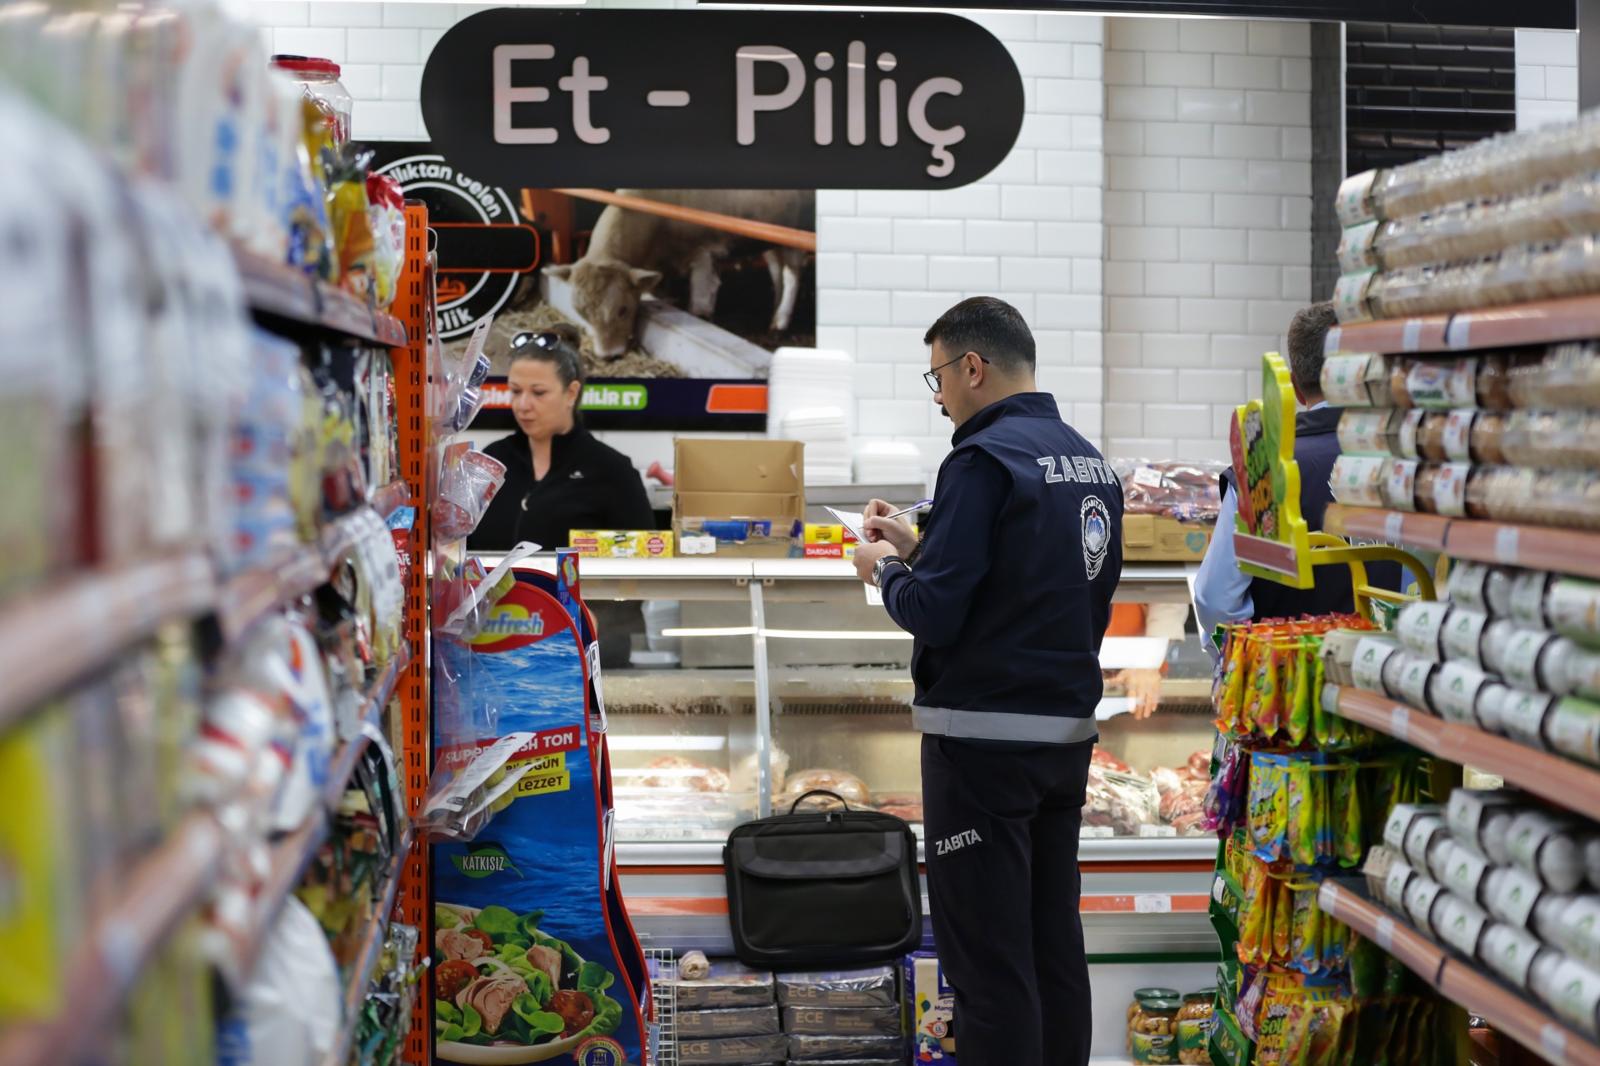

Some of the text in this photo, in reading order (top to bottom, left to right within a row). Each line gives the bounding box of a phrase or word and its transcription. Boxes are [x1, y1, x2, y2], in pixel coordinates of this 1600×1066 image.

[493, 40, 966, 178] Et - Piliç
[1037, 456, 1119, 487] ZABITA
[543, 732, 573, 748] TON
[935, 828, 983, 856] ZABITA
[462, 855, 505, 871] KATKISIZ
[795, 1011, 825, 1024] ECE
[681, 1043, 711, 1056] ECE
